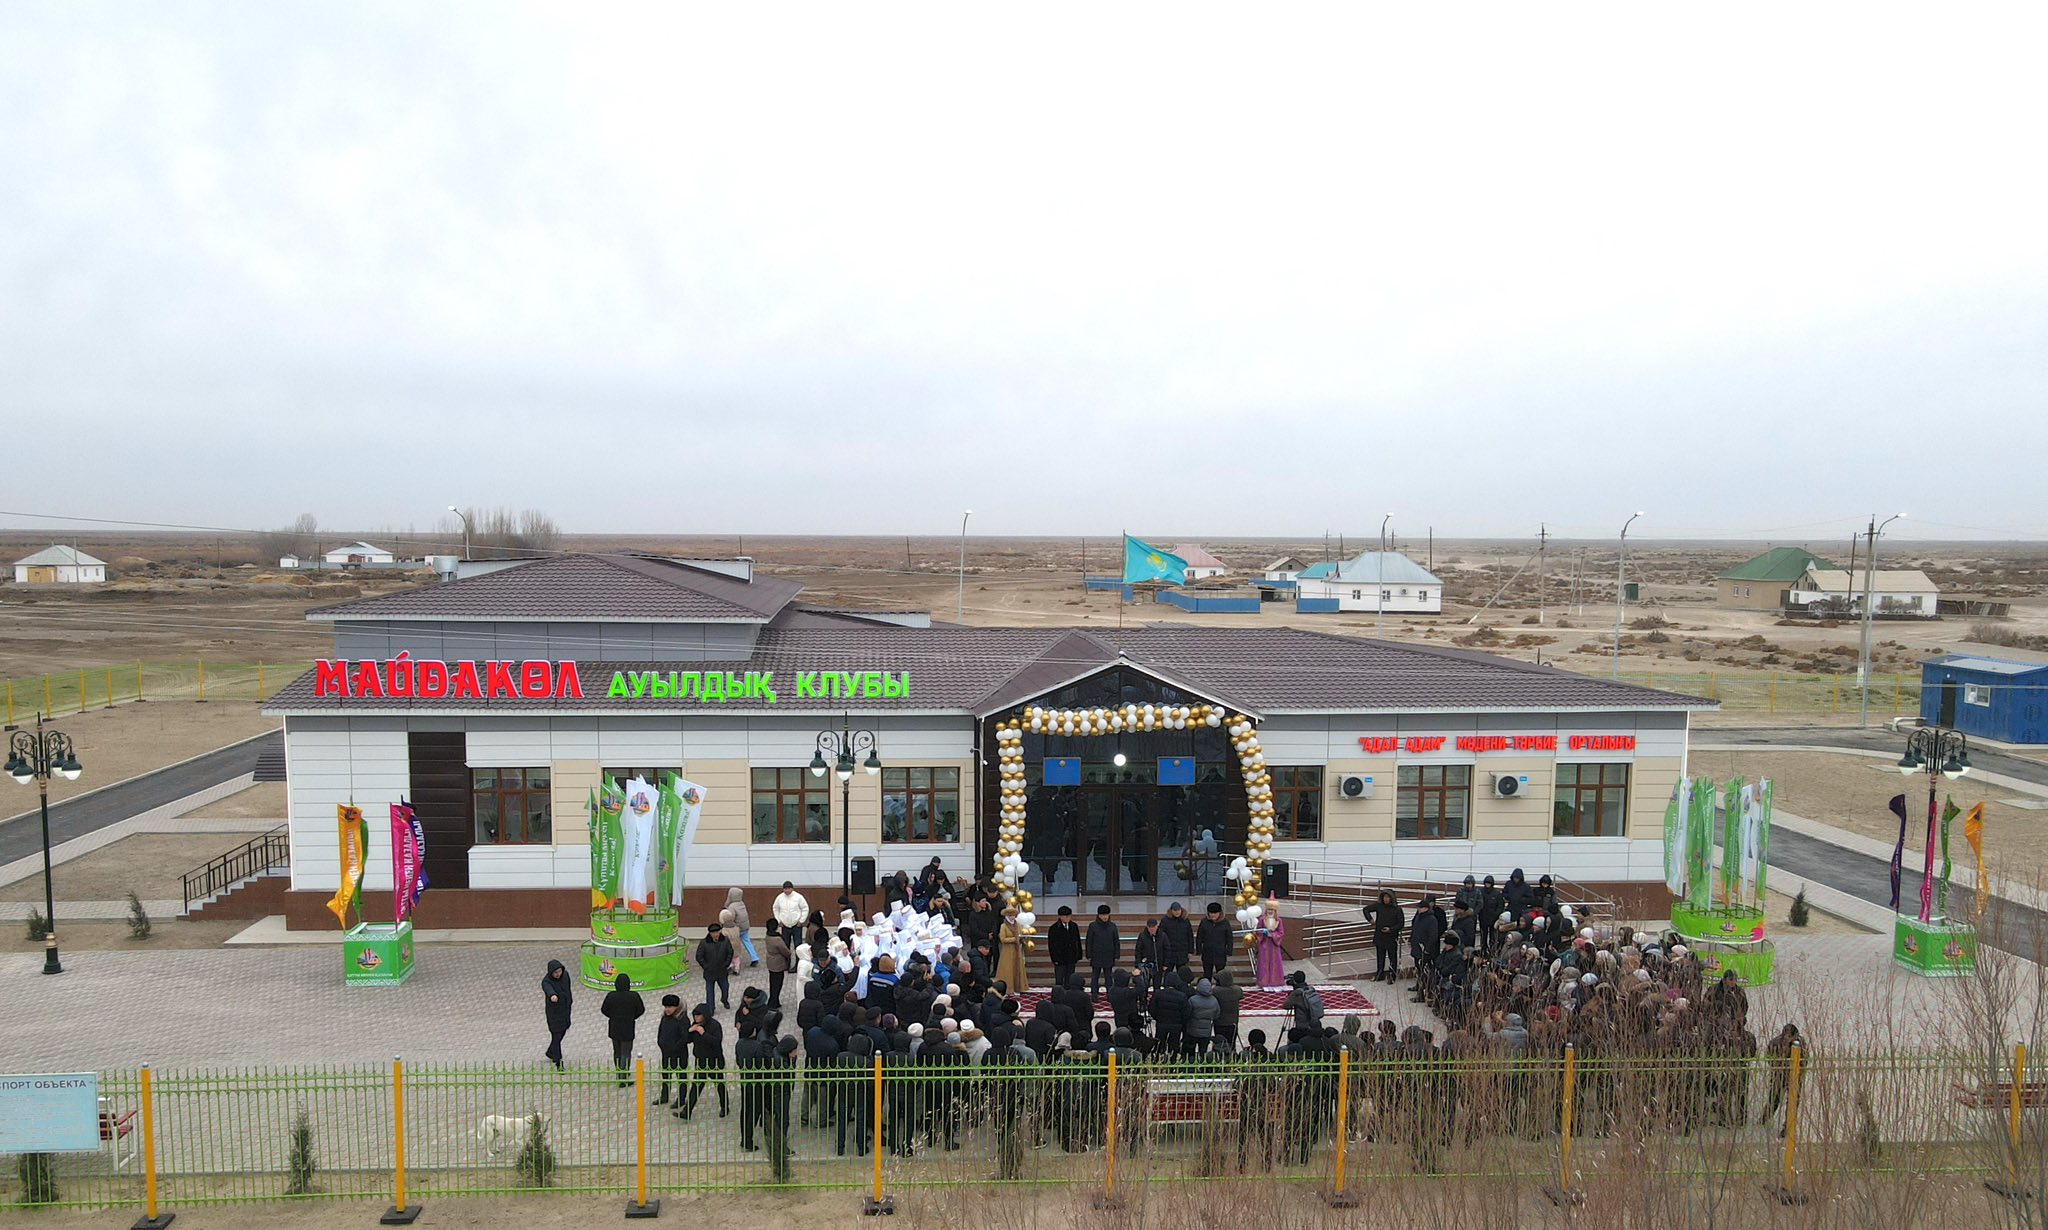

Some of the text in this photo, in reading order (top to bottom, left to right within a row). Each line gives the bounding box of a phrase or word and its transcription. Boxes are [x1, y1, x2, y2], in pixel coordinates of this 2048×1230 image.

[607, 671, 777, 703] АУЫЛДЫҚ
[796, 671, 910, 699] КЛУБЫ
[0, 1080, 87, 1090] ПОРТ ОБЪЕКТА
